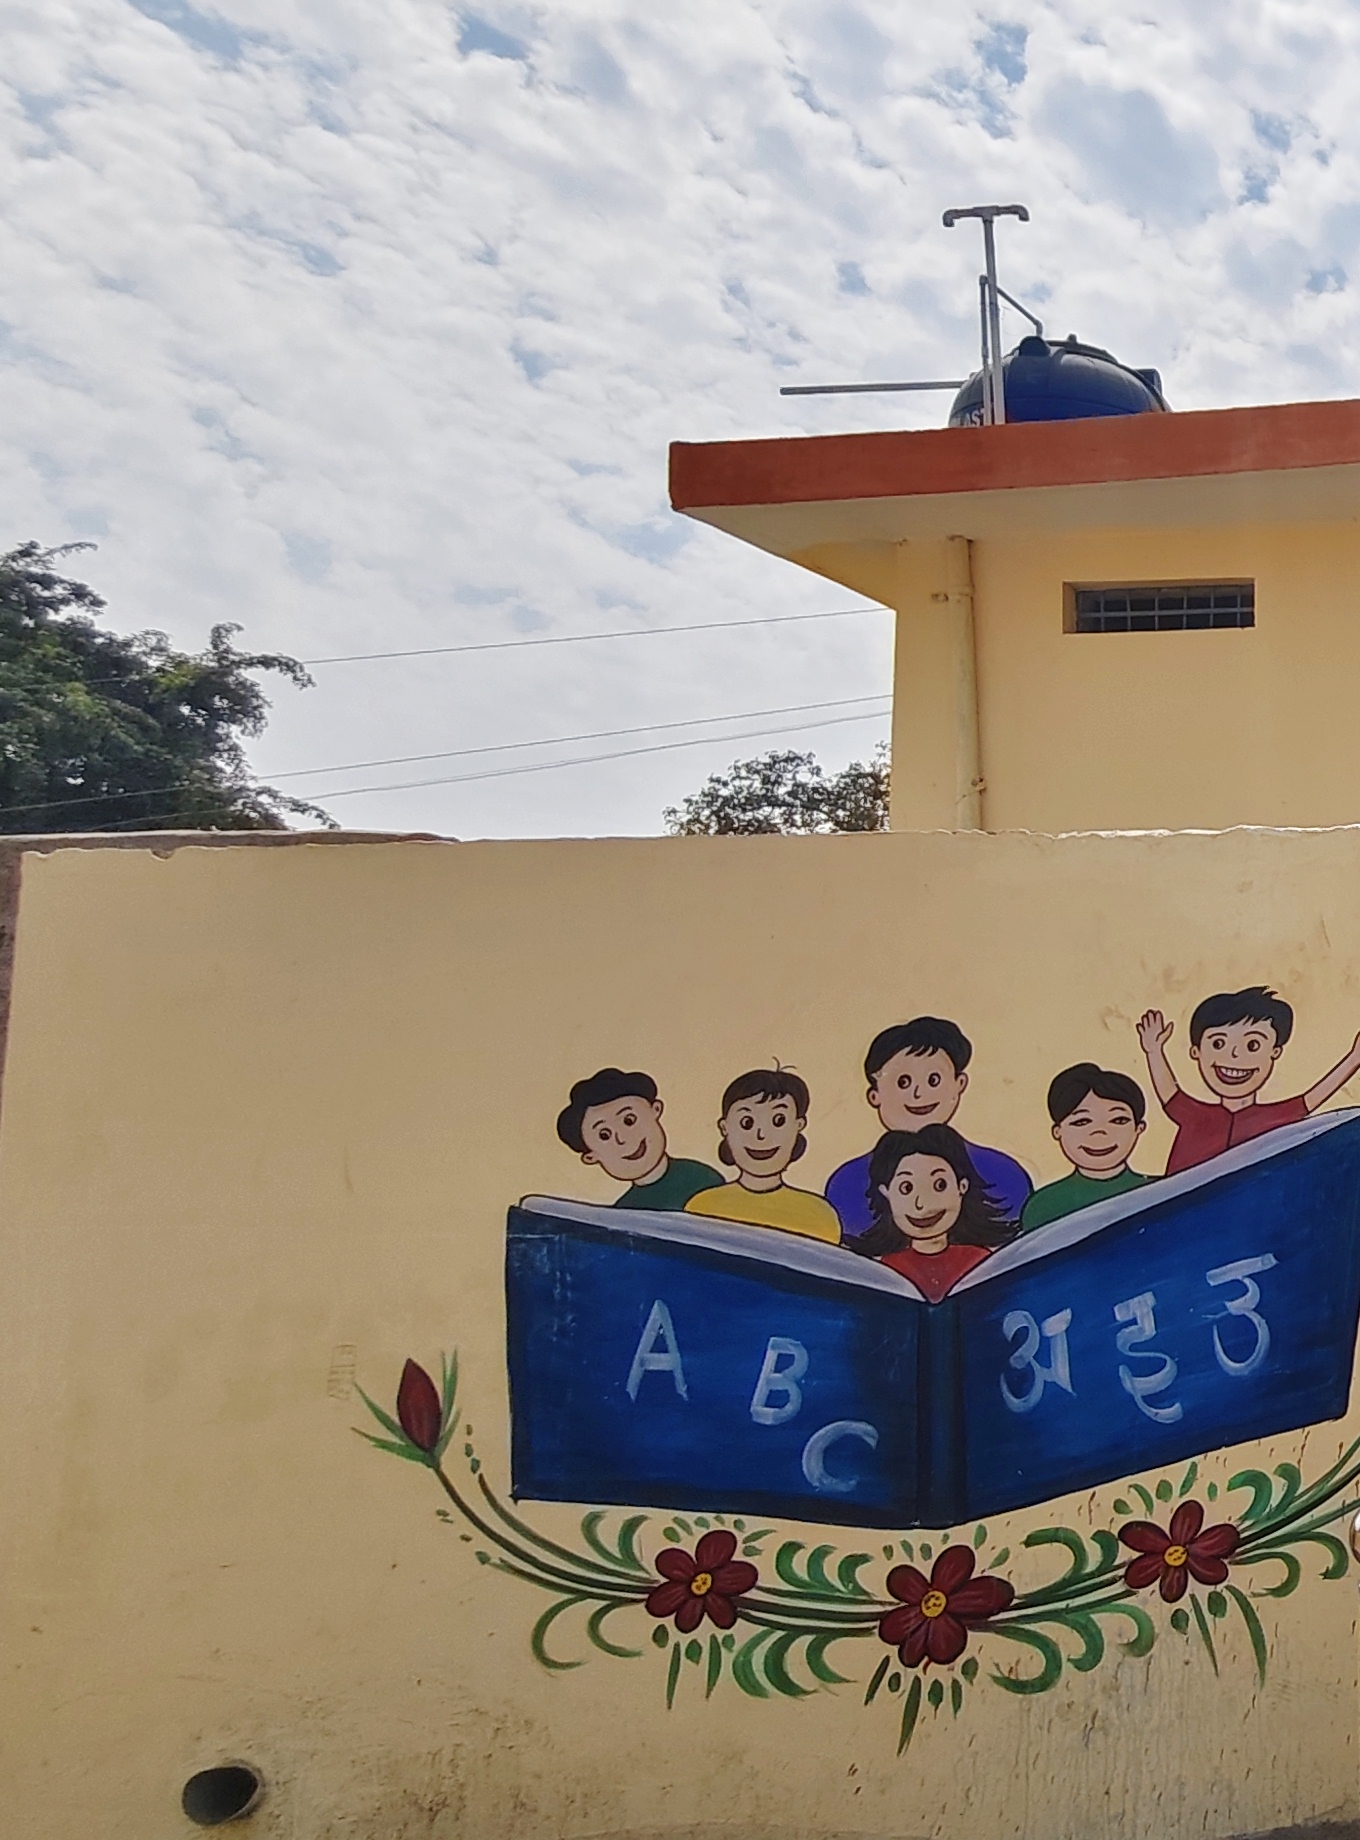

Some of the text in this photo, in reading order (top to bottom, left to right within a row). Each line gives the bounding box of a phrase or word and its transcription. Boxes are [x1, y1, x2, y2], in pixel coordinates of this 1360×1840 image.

[626, 1299, 878, 1492] A B C
[1000, 1253, 1279, 1424] अ इ उ
